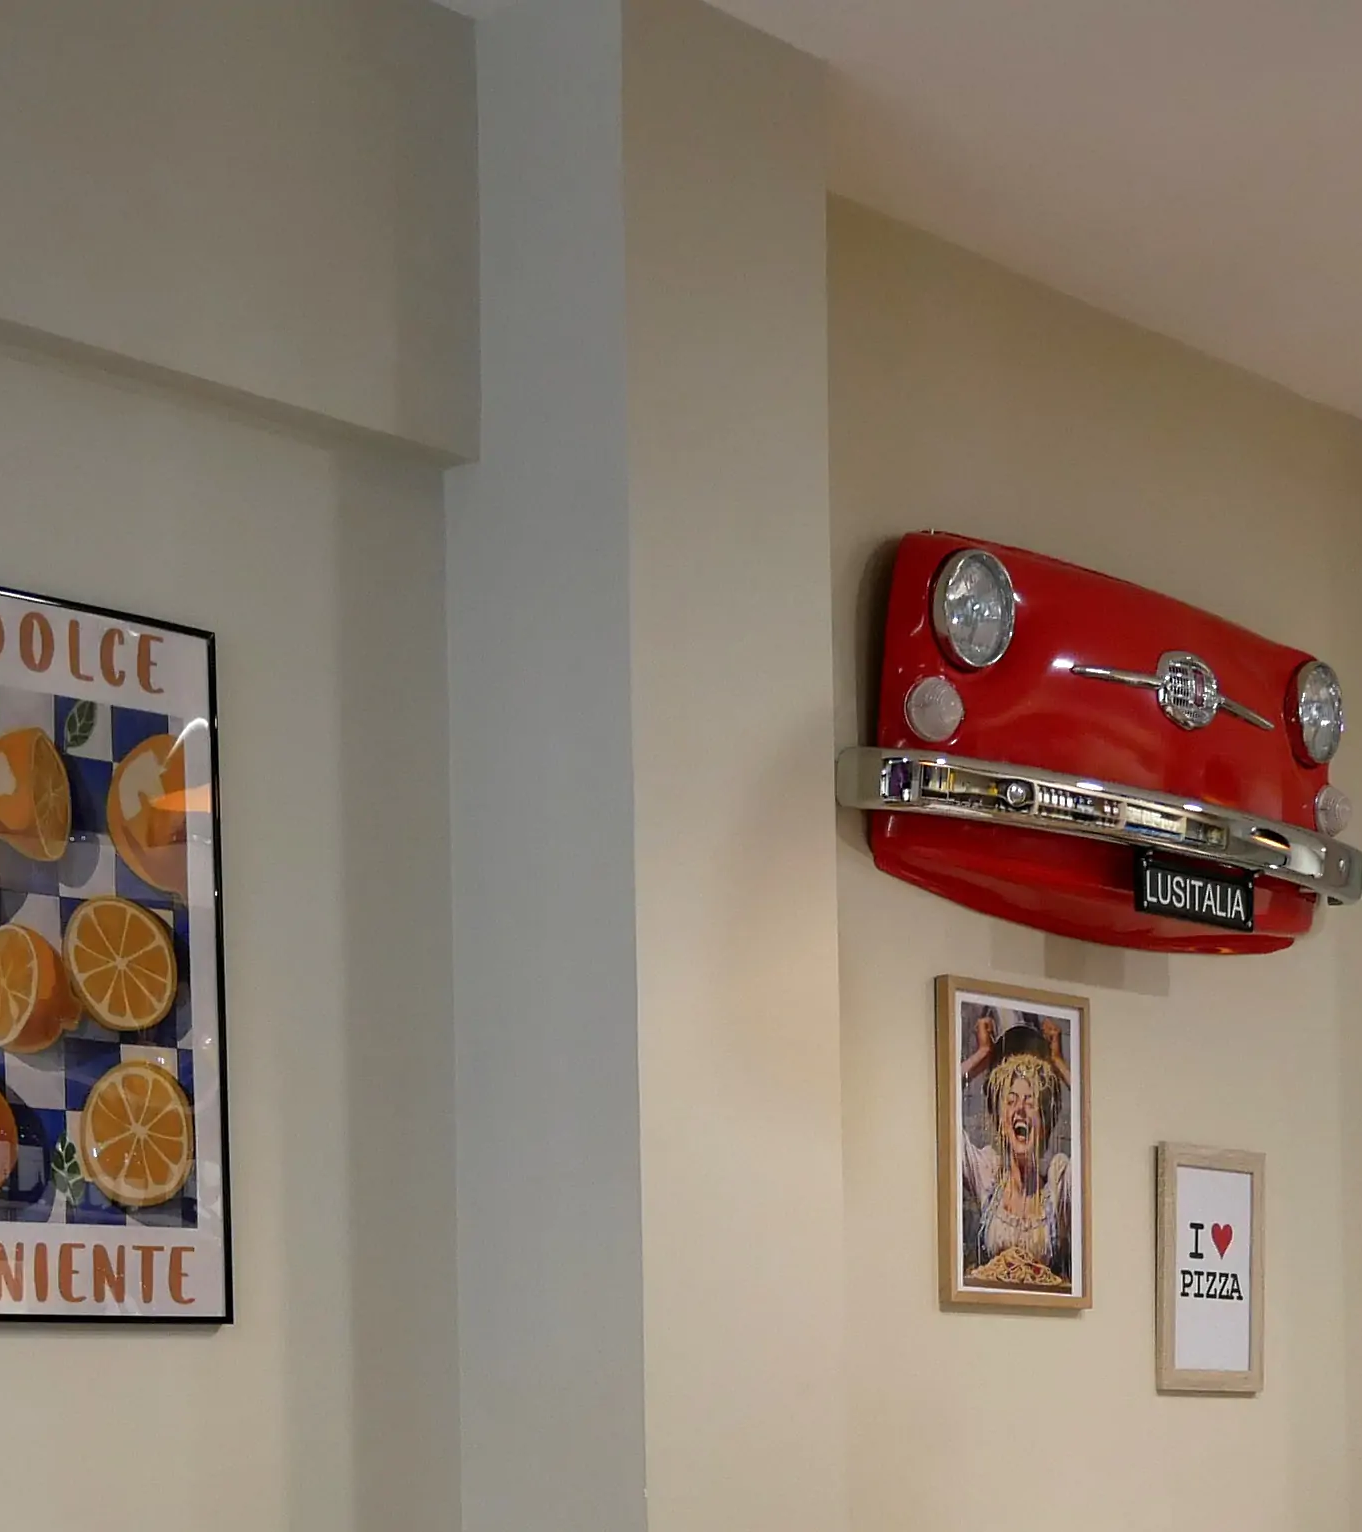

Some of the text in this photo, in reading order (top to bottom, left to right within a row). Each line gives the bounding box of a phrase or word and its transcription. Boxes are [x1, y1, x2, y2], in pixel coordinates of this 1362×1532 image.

[1146, 869, 1245, 921] LUSITALIA
[1189, 1222, 1205, 1260] I
[1180, 1269, 1244, 1301] PIZZA
